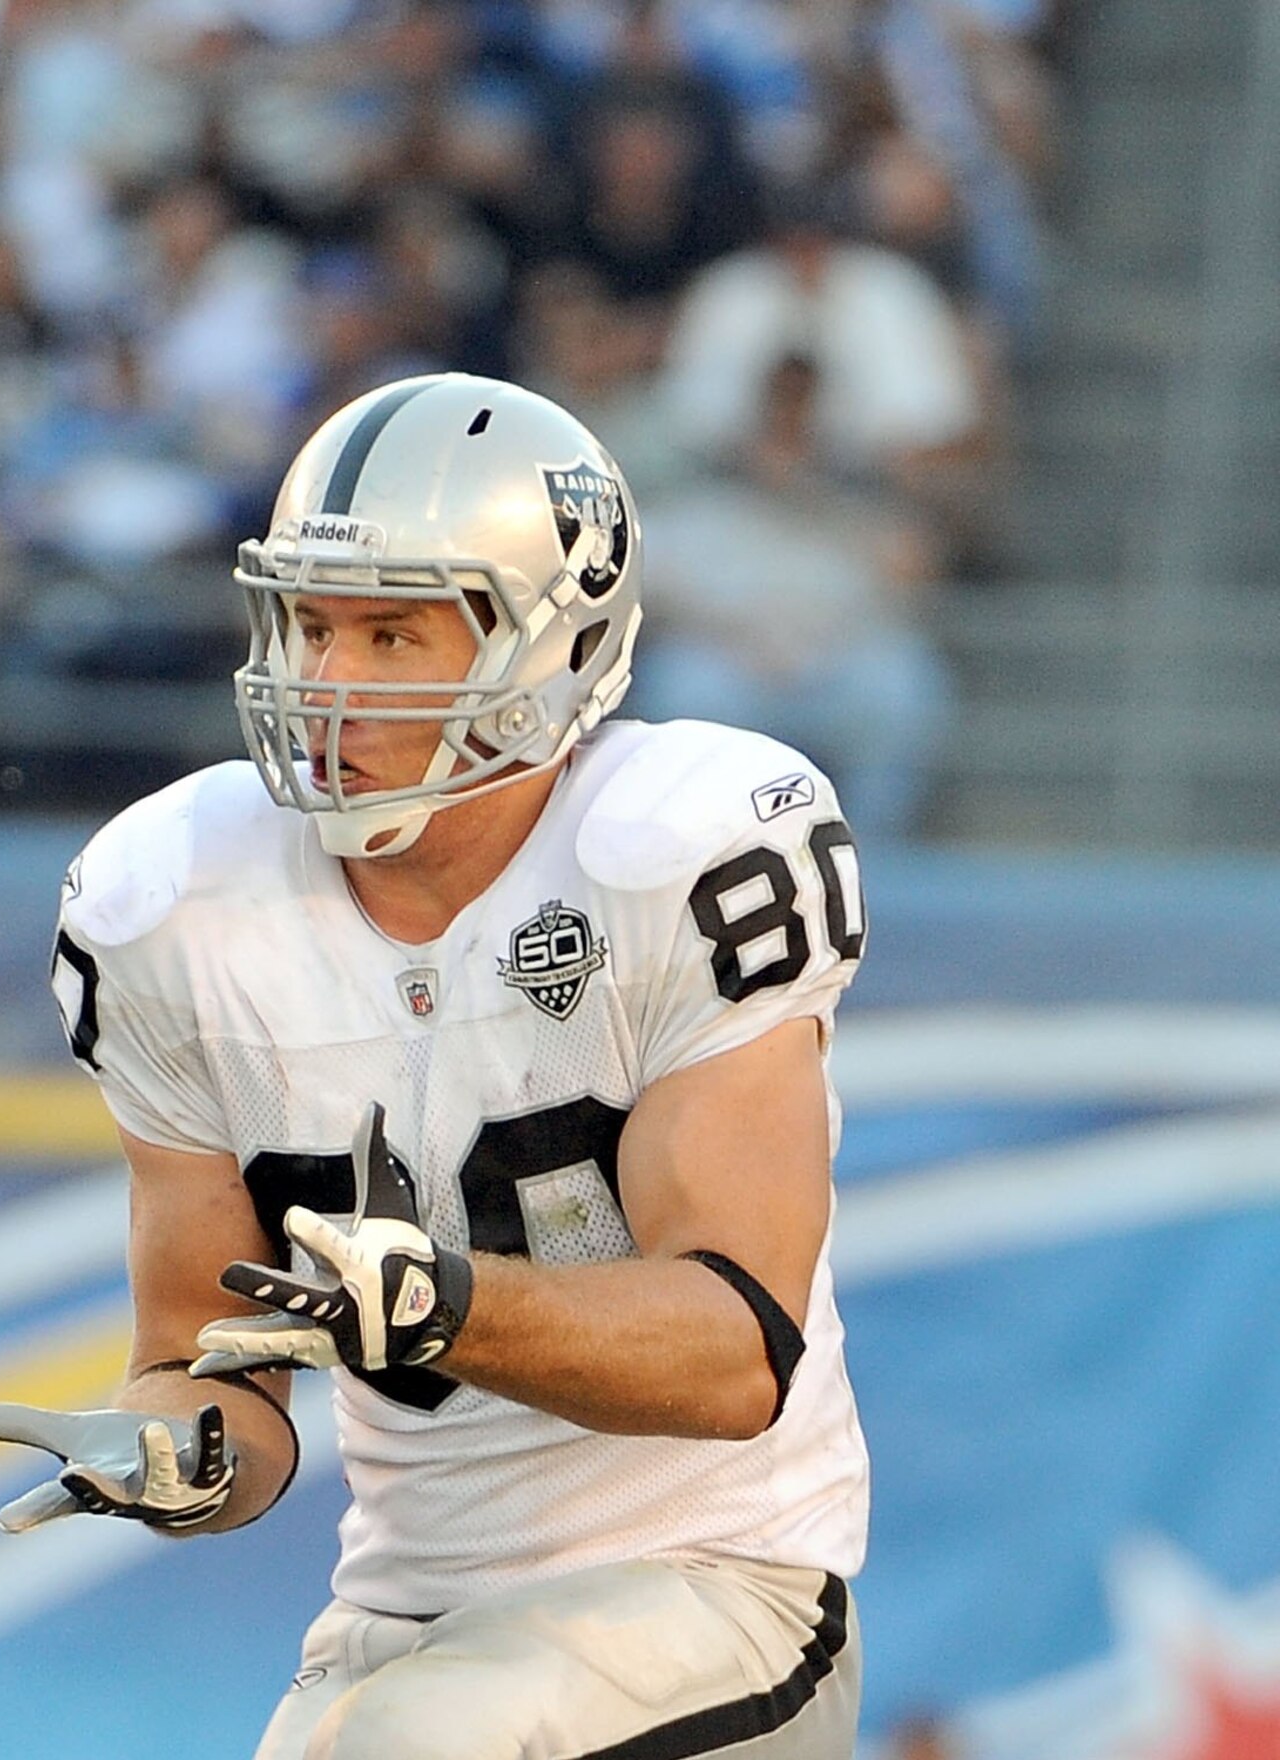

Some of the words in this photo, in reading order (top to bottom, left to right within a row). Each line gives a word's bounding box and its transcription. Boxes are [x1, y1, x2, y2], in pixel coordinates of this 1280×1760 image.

[300, 521, 359, 542] Riddell
[687, 821, 867, 1004] 80
[519, 926, 584, 971] 50
